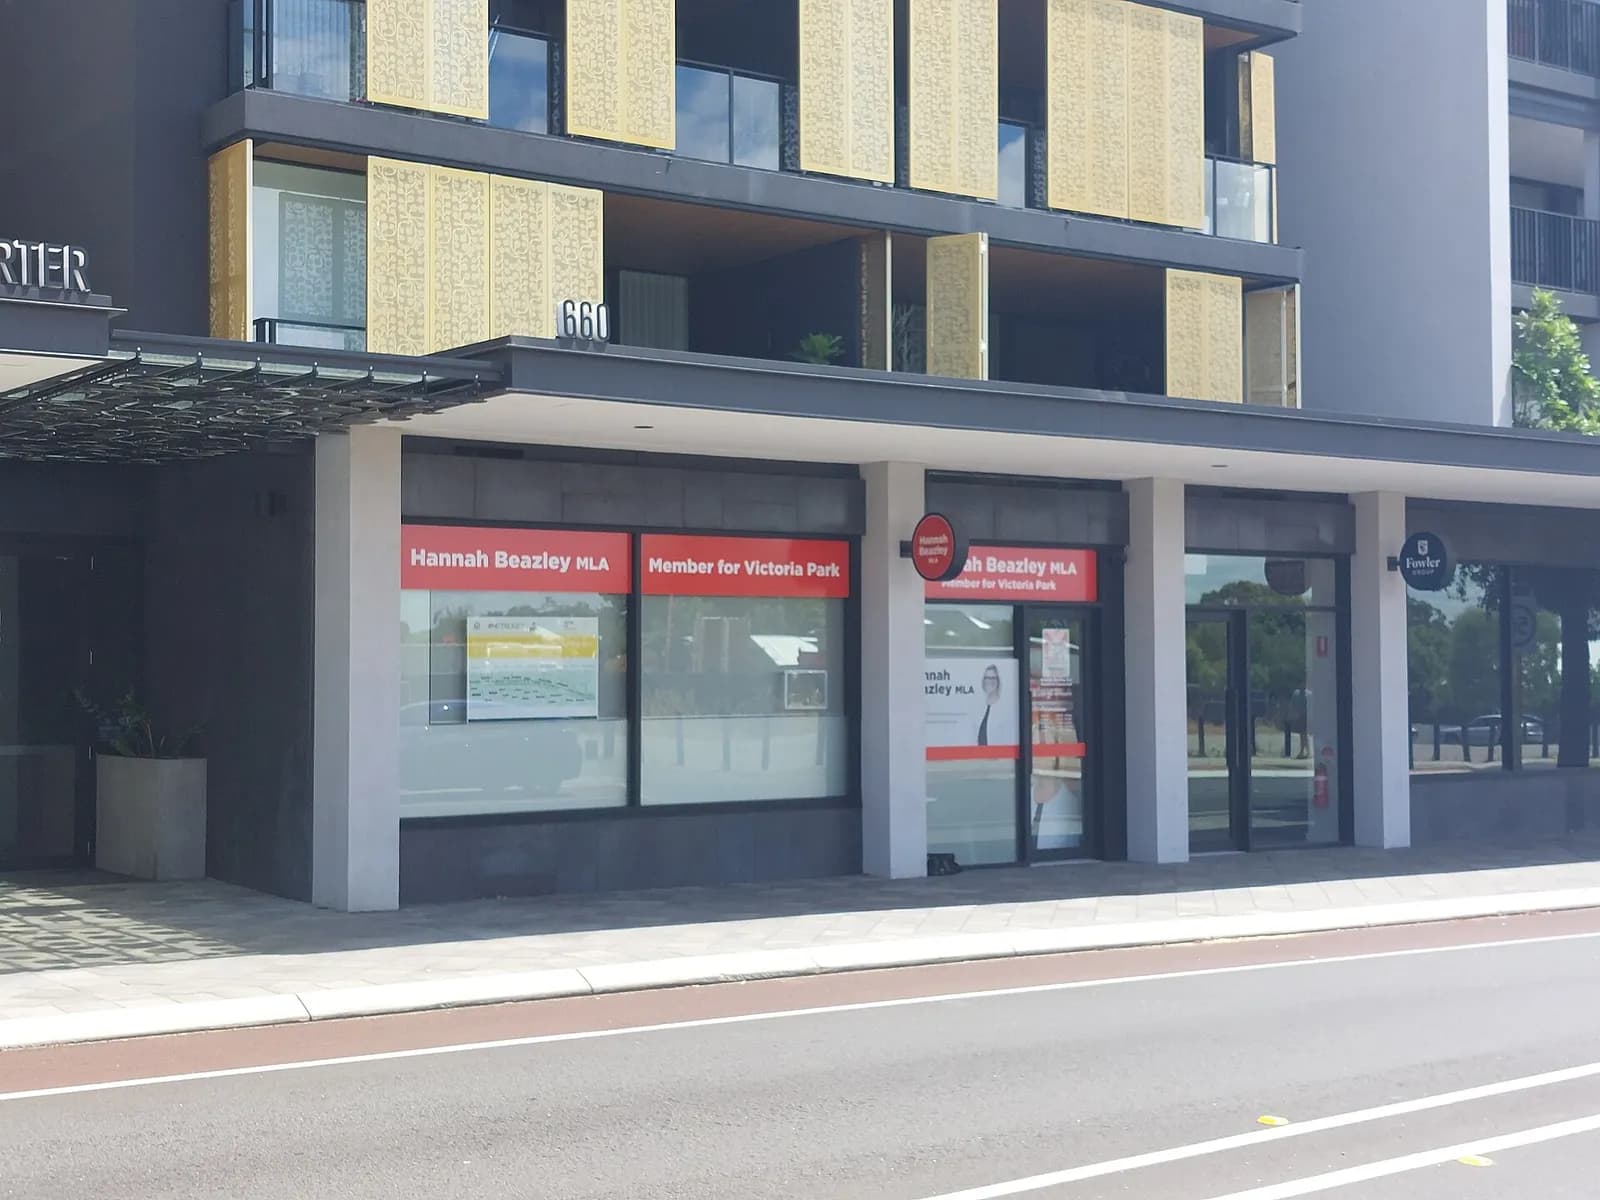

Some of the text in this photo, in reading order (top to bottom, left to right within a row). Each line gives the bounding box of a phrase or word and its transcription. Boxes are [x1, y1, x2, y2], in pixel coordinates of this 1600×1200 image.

[558, 299, 610, 341] 660
[410, 548, 610, 573] Hannah Beazley MLA
[648, 557, 840, 578] Member for Victoria Park
[986, 556, 1047, 577] Beazley
[1050, 561, 1077, 575] MLA
[1406, 556, 1441, 568] Fowler
[982, 578, 996, 590] for
[998, 578, 1034, 591] Victoria
[1035, 580, 1057, 591] Park
[955, 685, 975, 695] MLA
